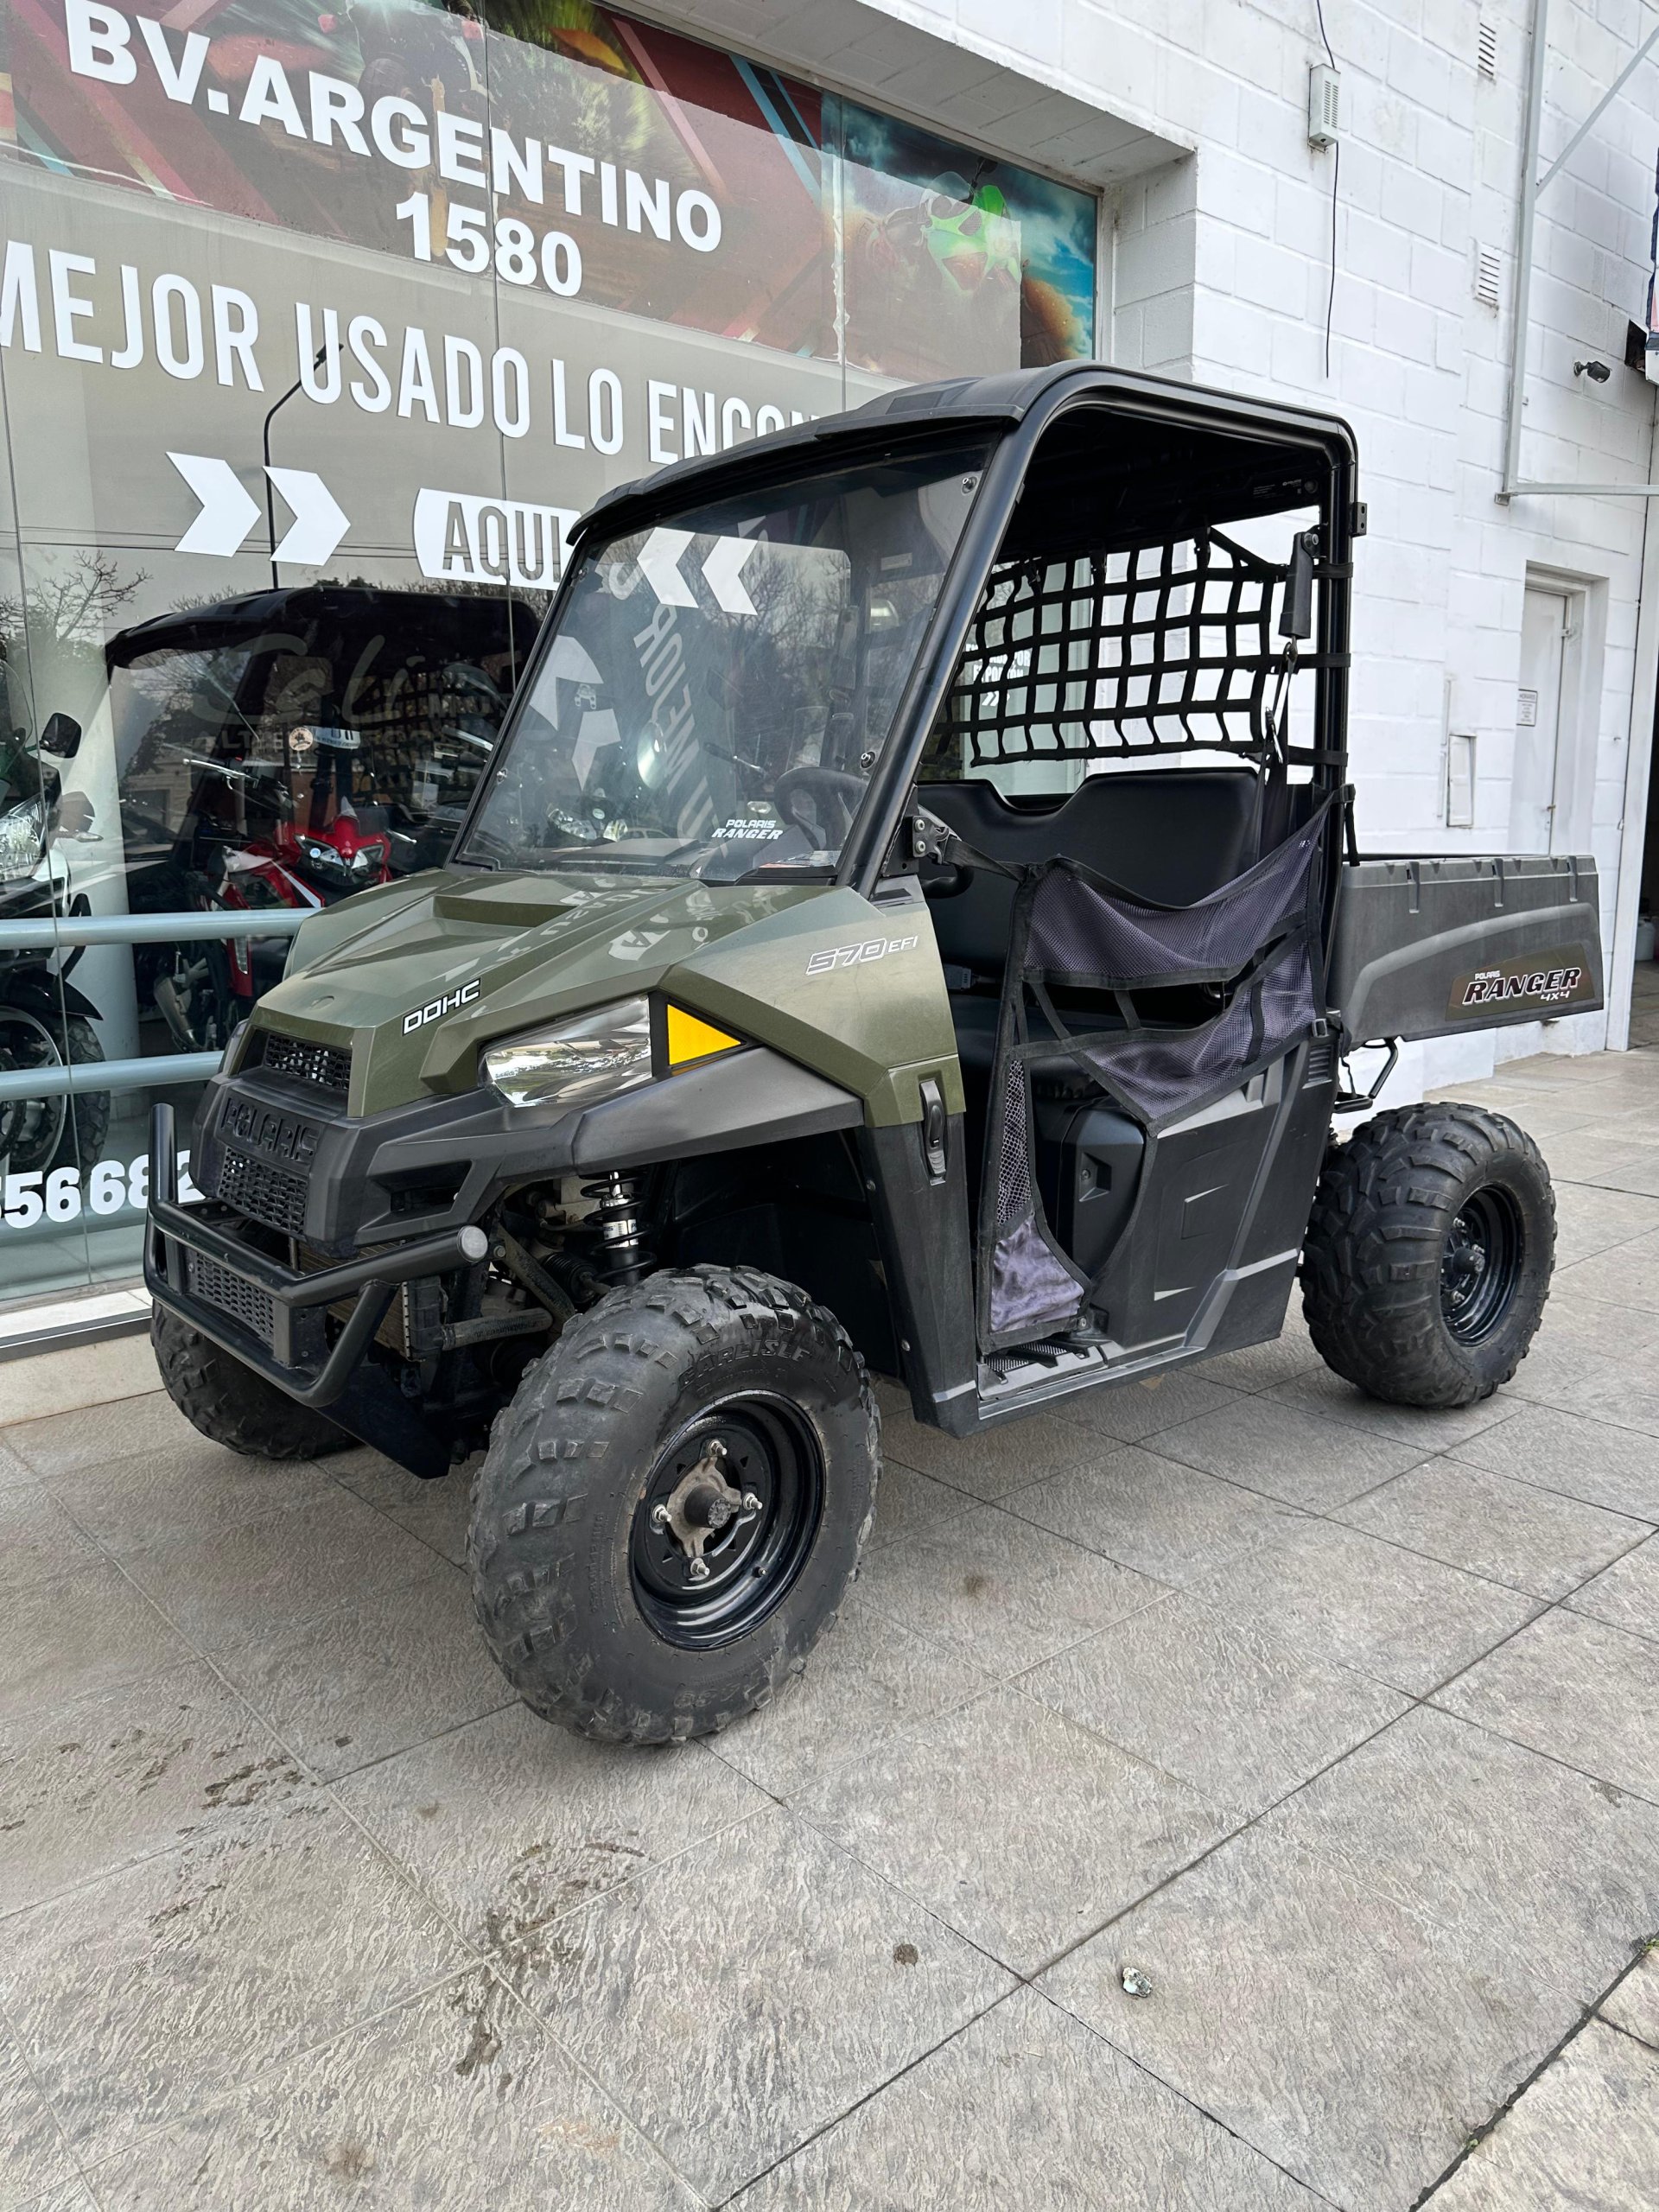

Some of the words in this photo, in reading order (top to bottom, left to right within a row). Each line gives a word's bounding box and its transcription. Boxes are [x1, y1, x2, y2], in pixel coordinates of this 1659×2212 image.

[396, 192, 582, 297] 1580
[296, 302, 531, 439] USADO
[552, 358, 624, 456] LO
[711, 827, 784, 840] RANGER
[726, 819, 777, 829] POLARIS
[804, 937, 887, 976] 570
[887, 935, 918, 954] EFI
[404, 979, 480, 1035] DOHC
[1461, 966, 1582, 1007] RANGER
[1540, 990, 1571, 1001] 4X4
[221, 1096, 319, 1161] POLARIS
